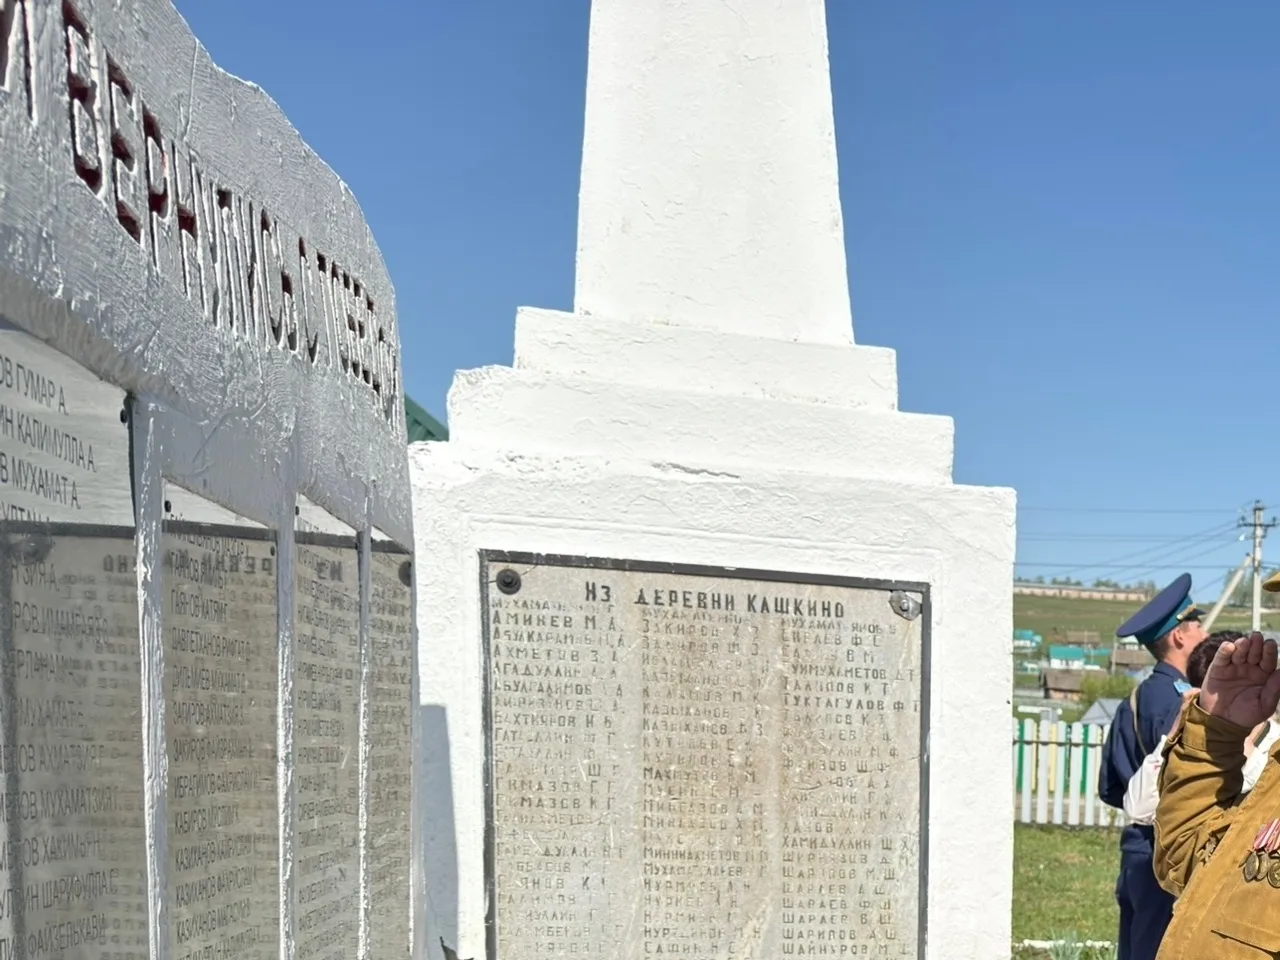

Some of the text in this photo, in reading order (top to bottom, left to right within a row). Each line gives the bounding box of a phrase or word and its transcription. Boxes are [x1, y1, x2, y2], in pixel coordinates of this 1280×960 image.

[16, 362, 55, 410] ГУМАР
[17, 410, 85, 469] КАЛИМУЛЛА
[11, 455, 68, 506] МУХАМАТ
[634, 587, 734, 611] ДЕРЕВНИ
[747, 595, 844, 618] КАШКИНО
[492, 609, 572, 628] АМИНЕВ
[493, 643, 579, 661] АХМЕТОВ
[781, 692, 884, 710] ТУКТАГУЛОВ
[893, 700, 904, 712] Ф
[781, 928, 856, 940] ШАРИПОВ
